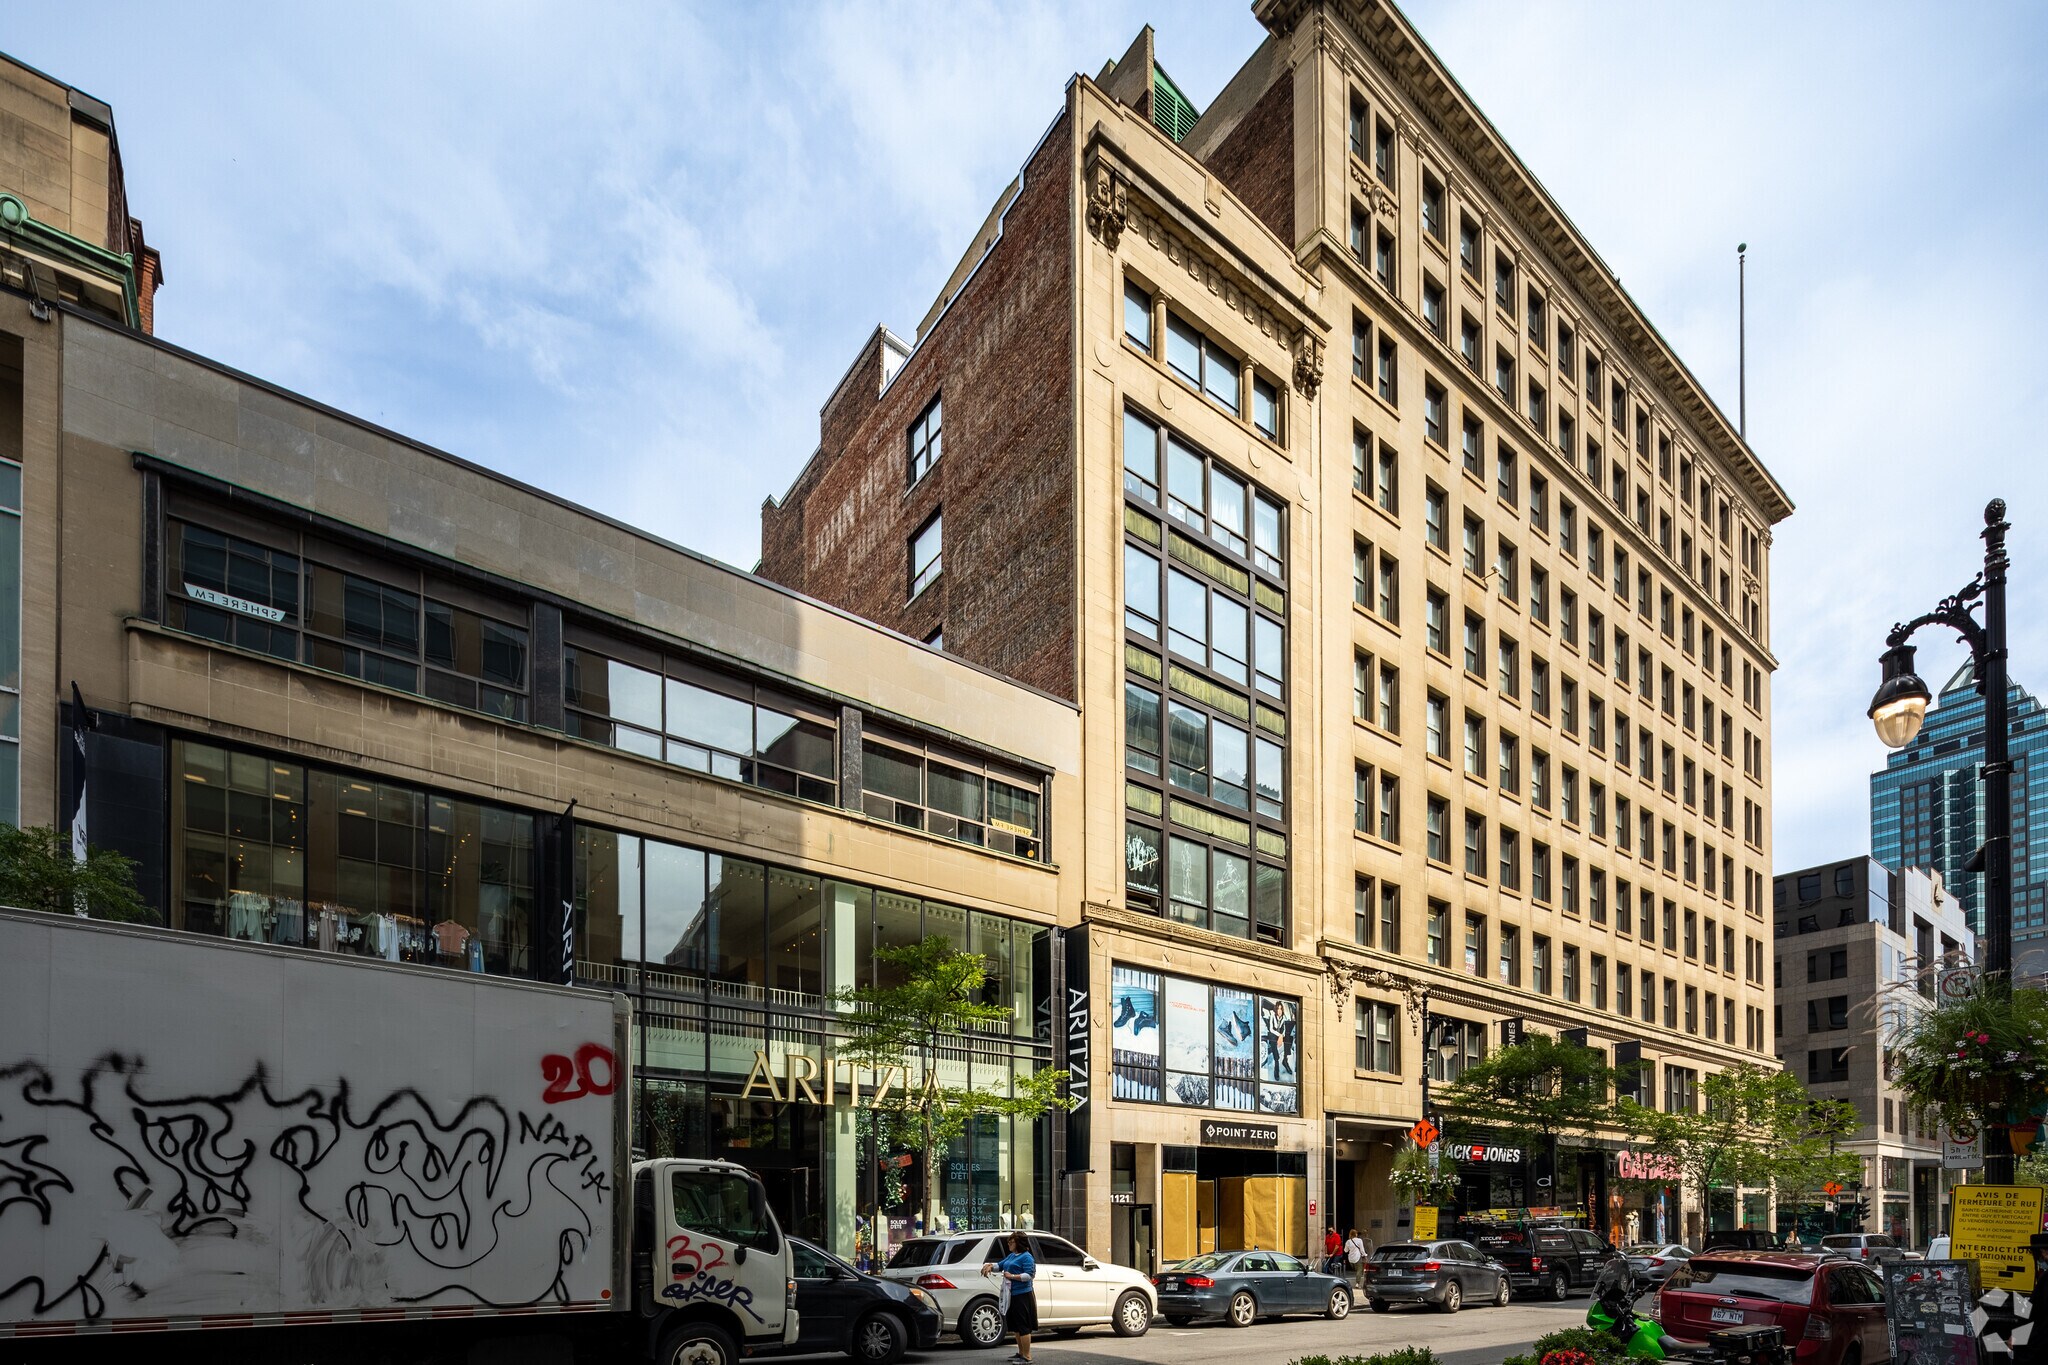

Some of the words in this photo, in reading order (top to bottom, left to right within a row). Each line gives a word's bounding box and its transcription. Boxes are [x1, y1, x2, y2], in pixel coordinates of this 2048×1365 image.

[1508, 1021, 1516, 1048] ONES
[1068, 987, 1089, 1115] ARITZIA
[541, 1042, 624, 1104] 20
[740, 1050, 948, 1113] ARITZIA
[1216, 1126, 1248, 1138] POINT
[1250, 1129, 1277, 1140] ZERO
[1444, 1144, 1473, 1160] ACK
[1482, 1146, 1521, 1163] JONES
[950, 1197, 977, 1206] RABAS
[1110, 1194, 1130, 1203] 1121
[1975, 1191, 1999, 1199] AVIS
[1958, 1198, 2003, 1206] FERMETURE
[2020, 1200, 2037, 1208] RUE
[1955, 1243, 2033, 1254] INTERDICTION
[666, 1235, 729, 1281] 32
[1975, 1252, 2024, 1262] STATIONNER
